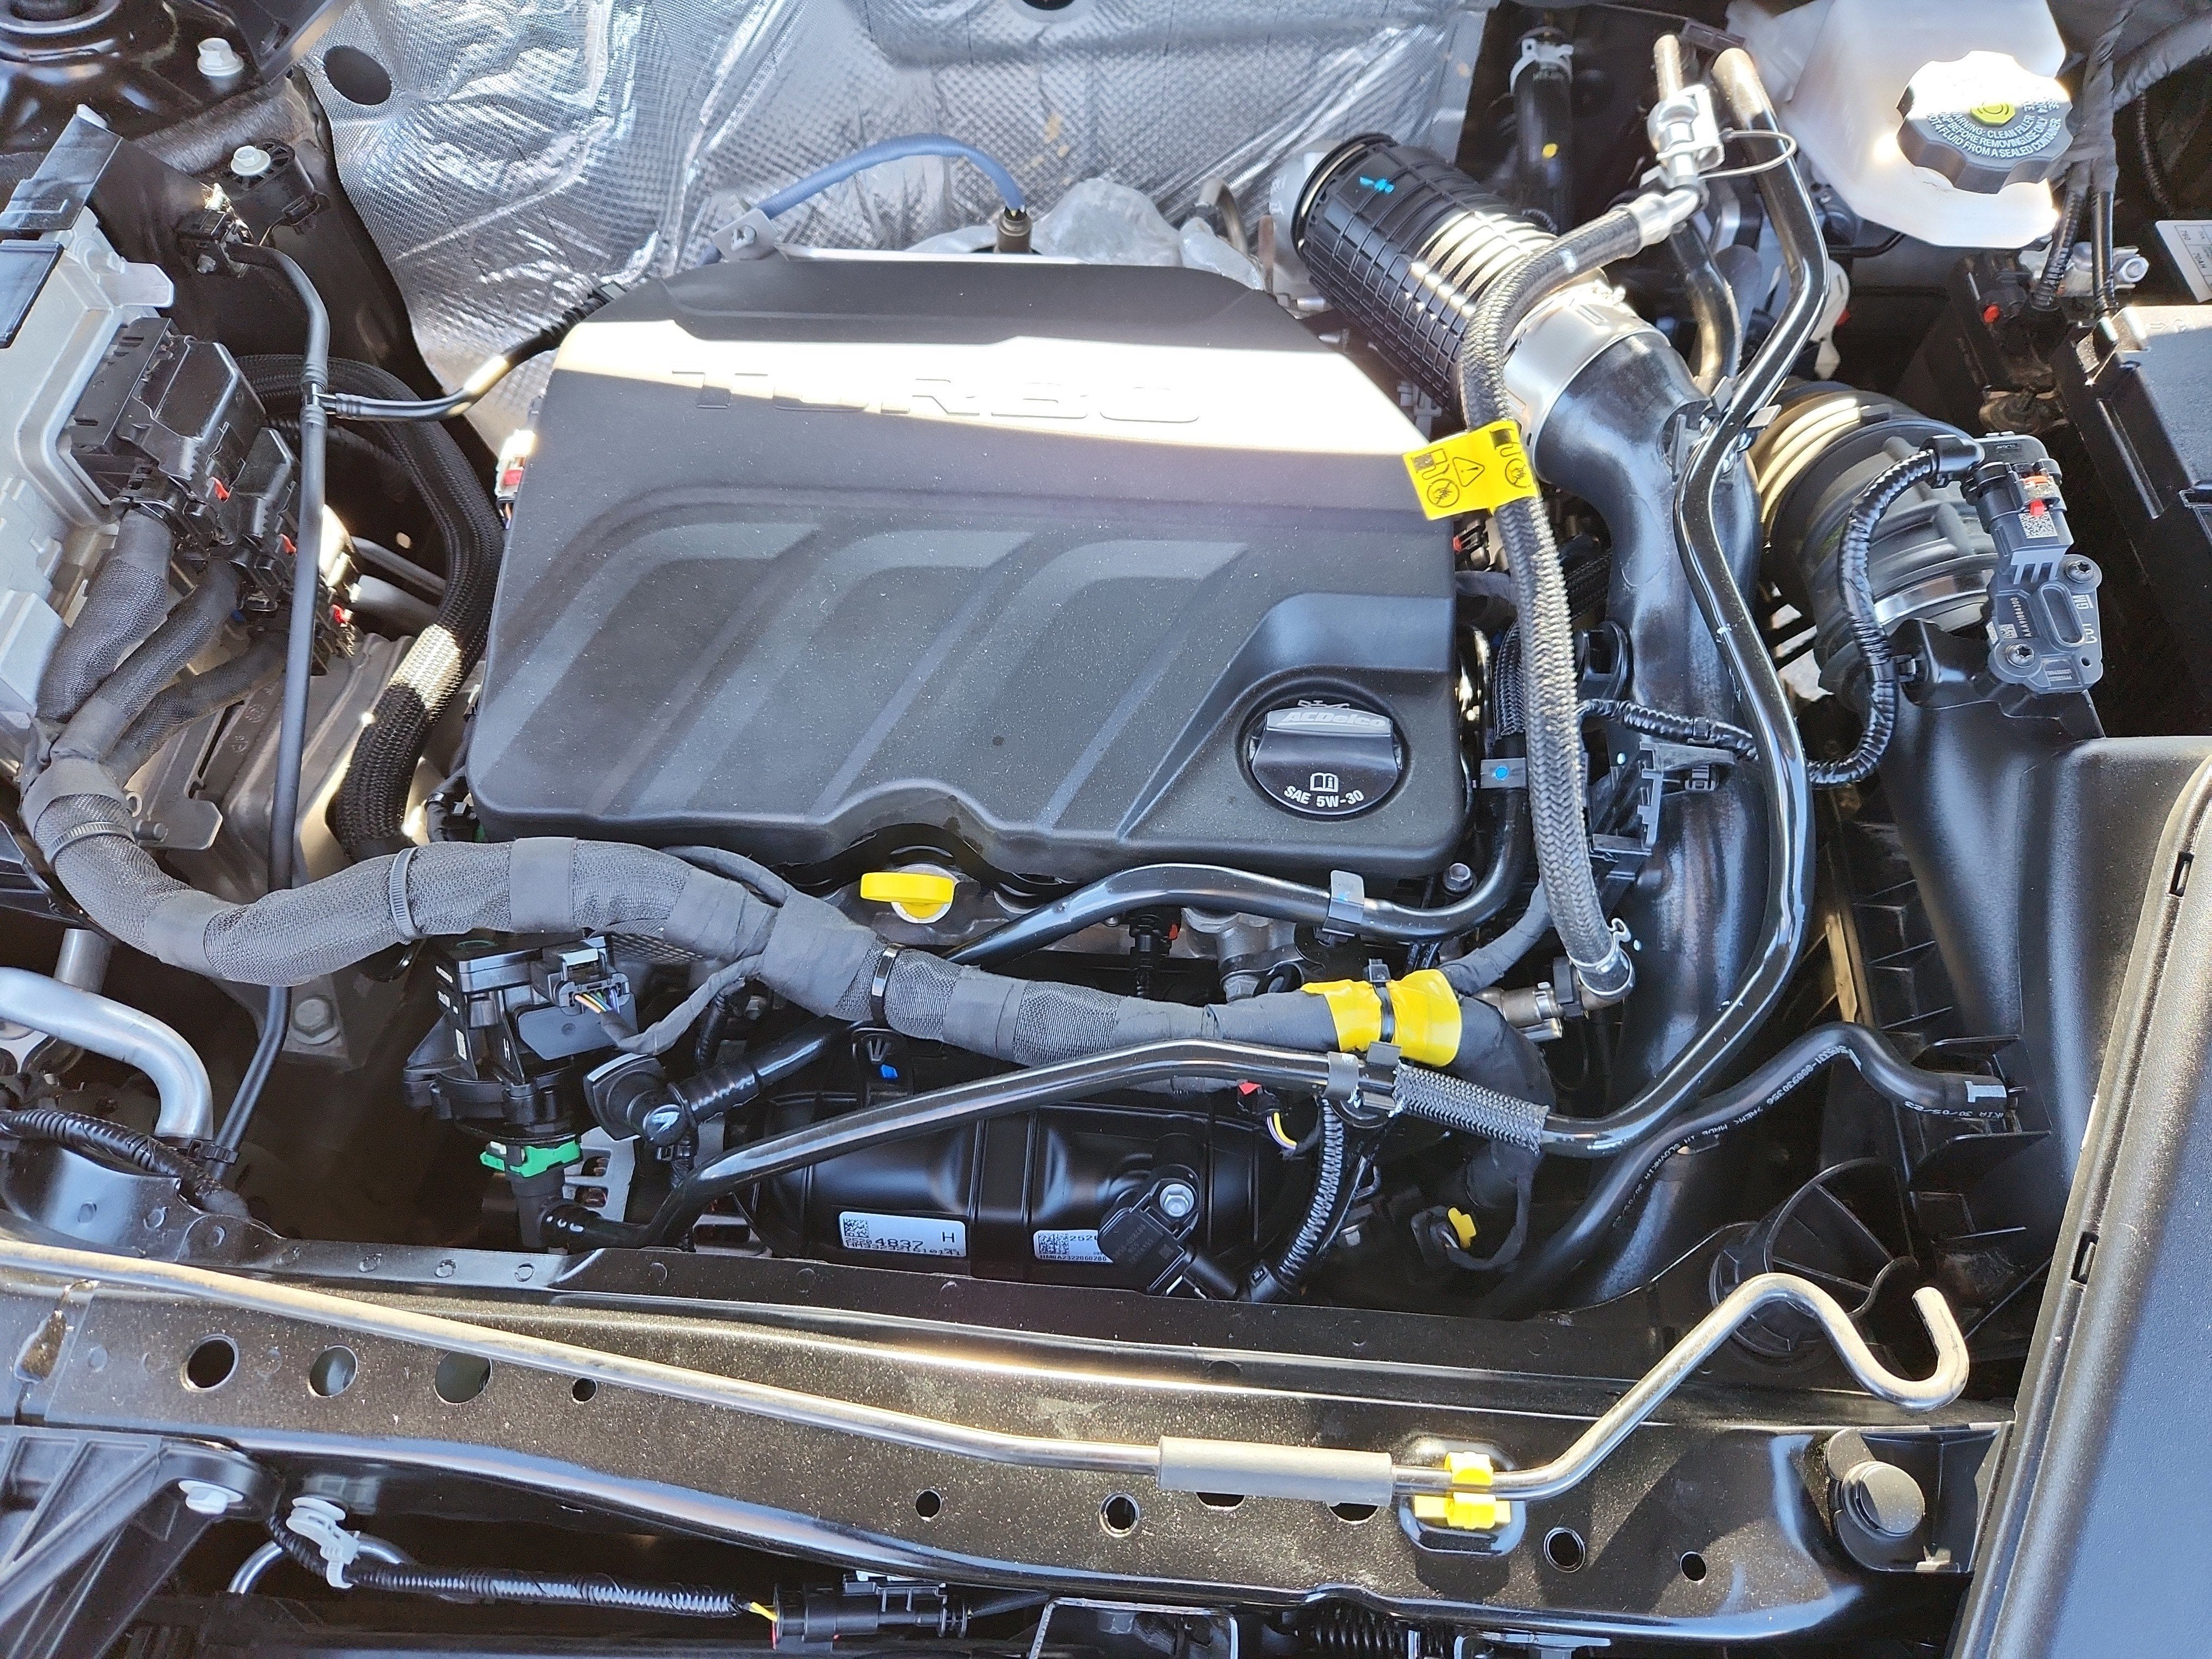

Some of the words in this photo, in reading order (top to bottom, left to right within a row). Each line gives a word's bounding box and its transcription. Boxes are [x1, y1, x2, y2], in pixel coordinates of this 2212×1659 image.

[1926, 113, 1945, 131] OT4
[1938, 127, 1963, 146] FLUID
[1963, 141, 1990, 156] FROM
[1991, 149, 1998, 157] A
[1999, 145, 2034, 158] SEALED
[2031, 118, 2061, 151] CONTAINER
[1938, 112, 1953, 123] AP
[1947, 121, 1980, 144] BEFORE
[2033, 116, 2048, 133] ONLY
[1987, 129, 2017, 139] CLEAN
[2014, 114, 2035, 134] FILLER
[2072, 594, 2092, 609] GM
[1282, 712, 1386, 727] ACDelco
[1284, 786, 1311, 805] SAE
[1316, 789, 1364, 808] 5W-30
[942, 1231, 955, 1243] H
